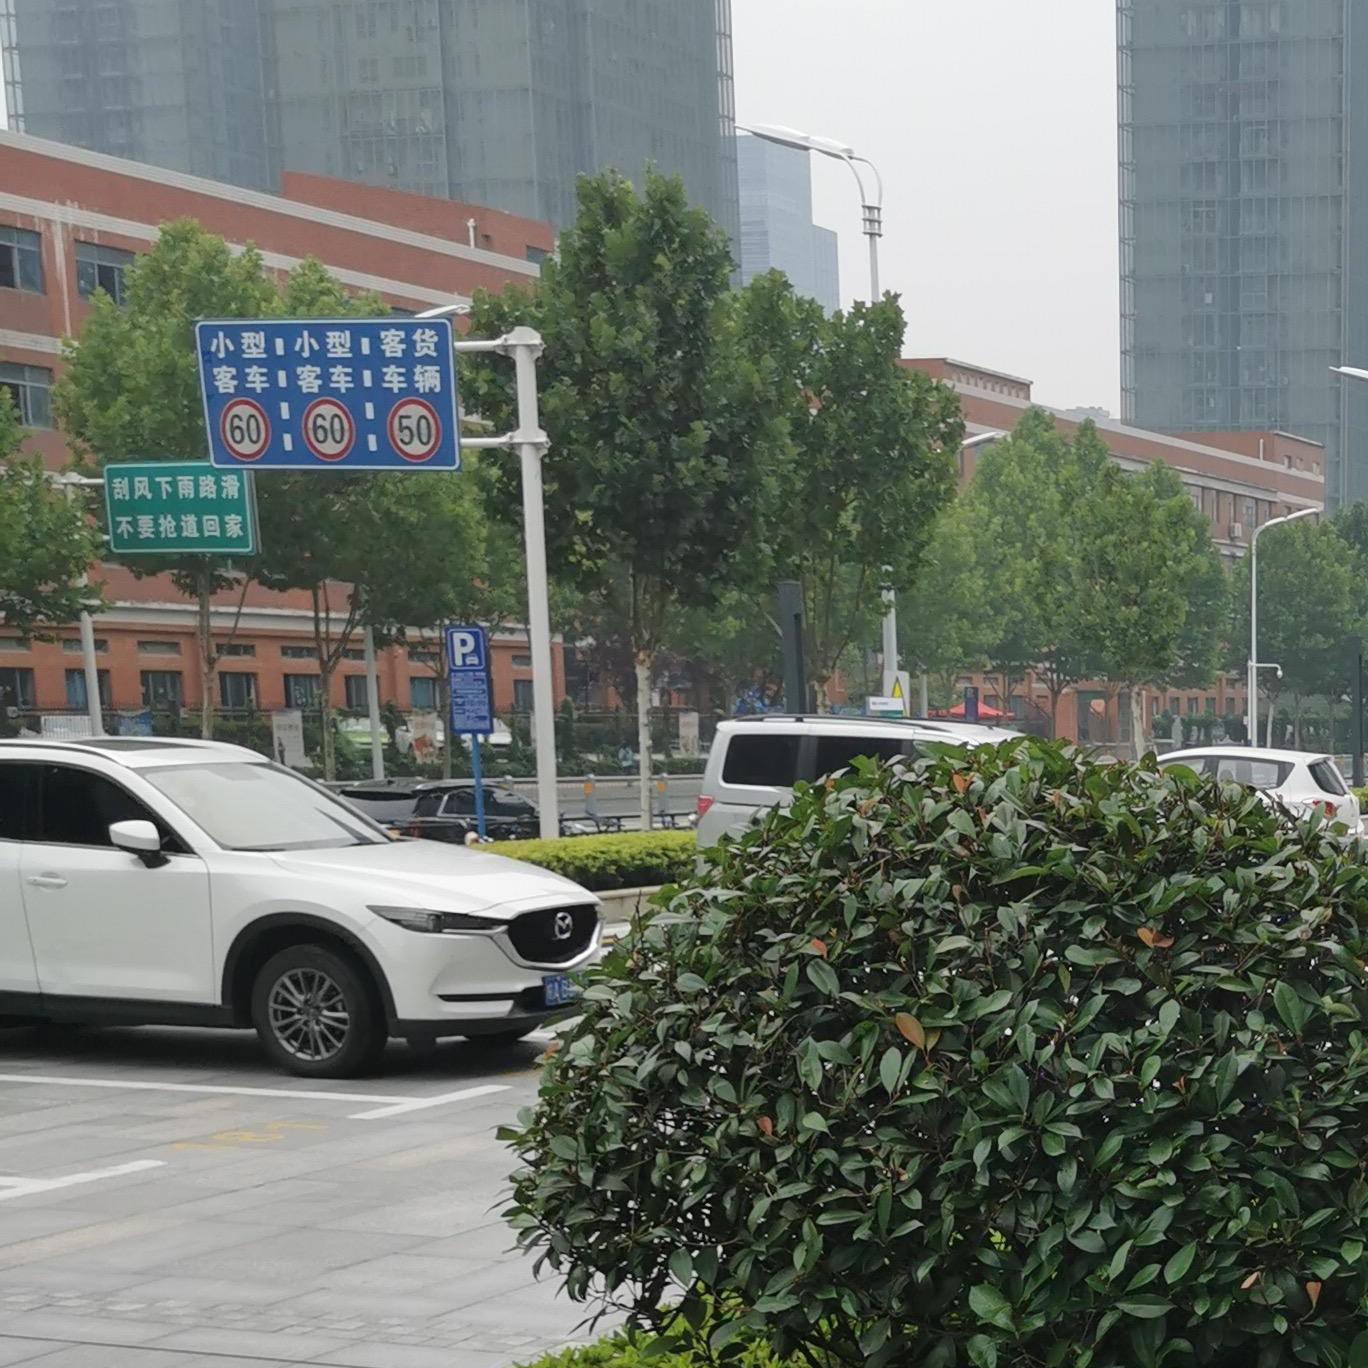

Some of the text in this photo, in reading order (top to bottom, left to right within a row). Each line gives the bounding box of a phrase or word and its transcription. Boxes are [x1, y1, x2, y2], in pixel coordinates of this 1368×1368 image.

[210, 328, 439, 359] 小型 小型 客货
[212, 364, 441, 394] 客车 客车 车辆
[229, 412, 433, 446] 60 60 50
[112, 474, 240, 500] 刮风下雨路滑
[115, 513, 244, 539] 不要抢道回家
[452, 632, 475, 666] P
